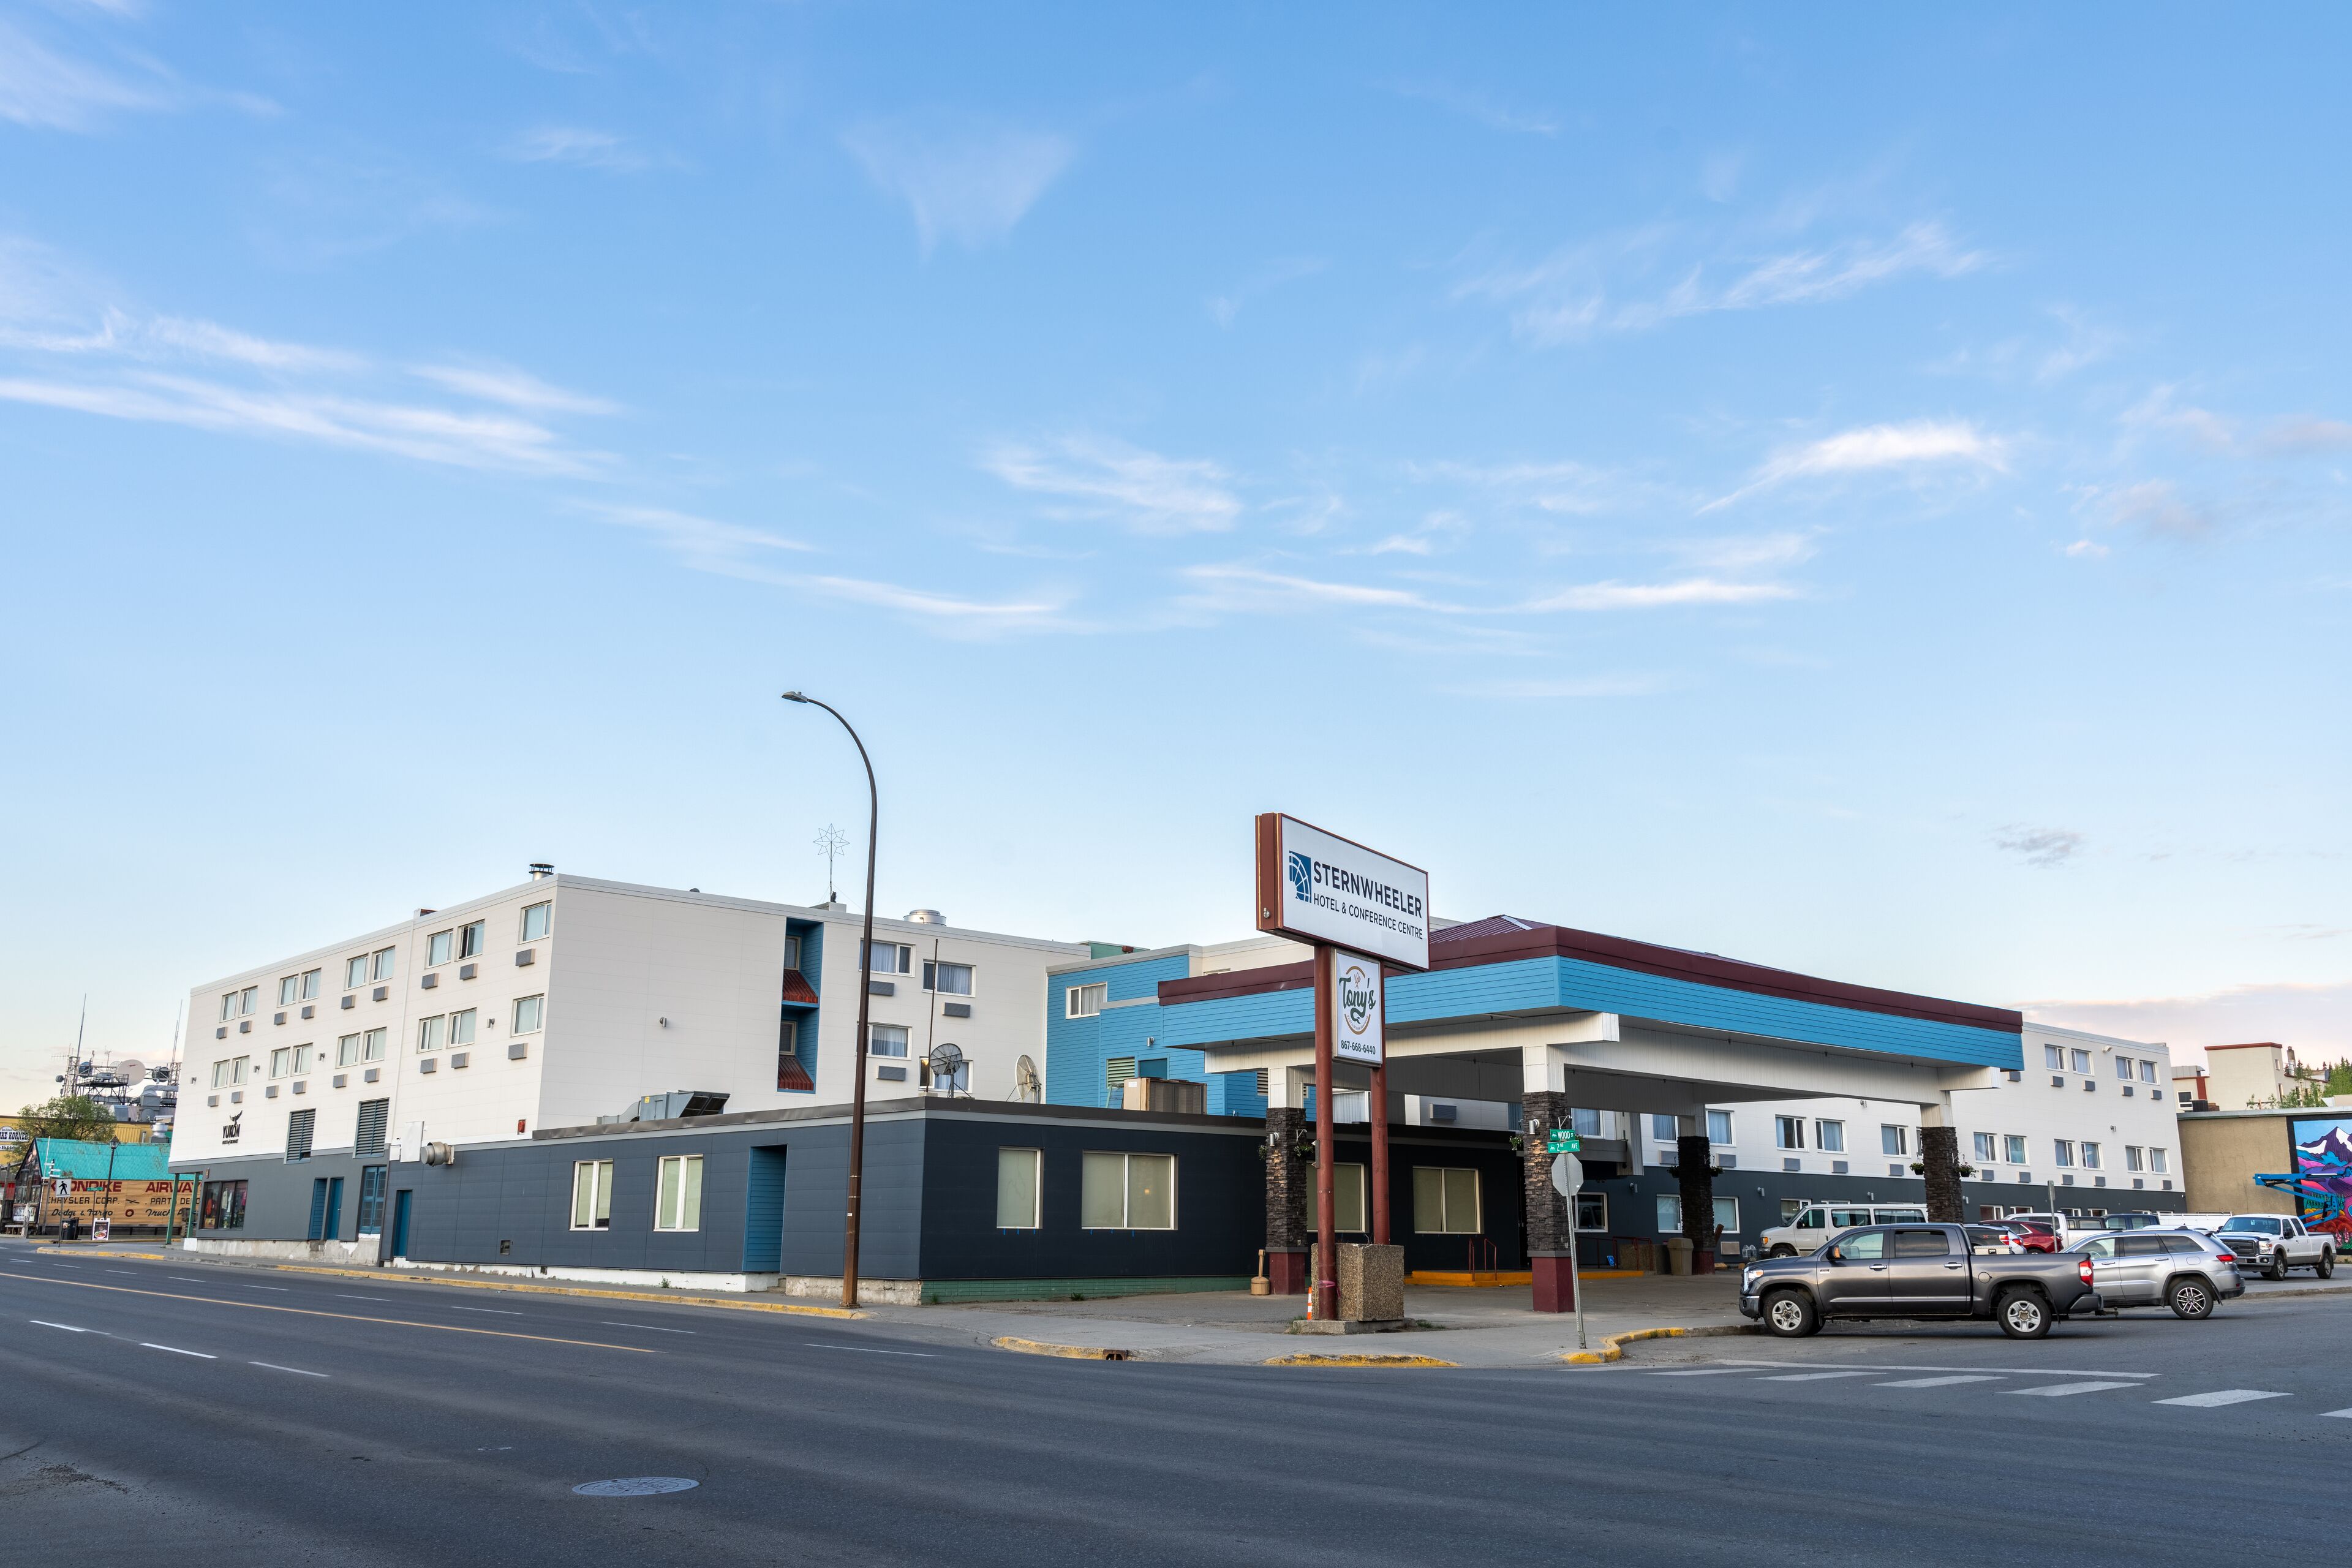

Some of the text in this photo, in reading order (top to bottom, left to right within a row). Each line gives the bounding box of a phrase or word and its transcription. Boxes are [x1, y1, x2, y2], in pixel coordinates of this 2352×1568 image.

[1313, 861, 1422, 919] STERNWHEELER
[1313, 892, 1423, 940] HOTEL & CONFERENCE CENTRE
[1339, 976, 1376, 1025] Tony's
[1341, 1040, 1376, 1055] 867-668-6440
[9, 1131, 28, 1140] KORNER
[223, 1124, 240, 1139] YUKON
